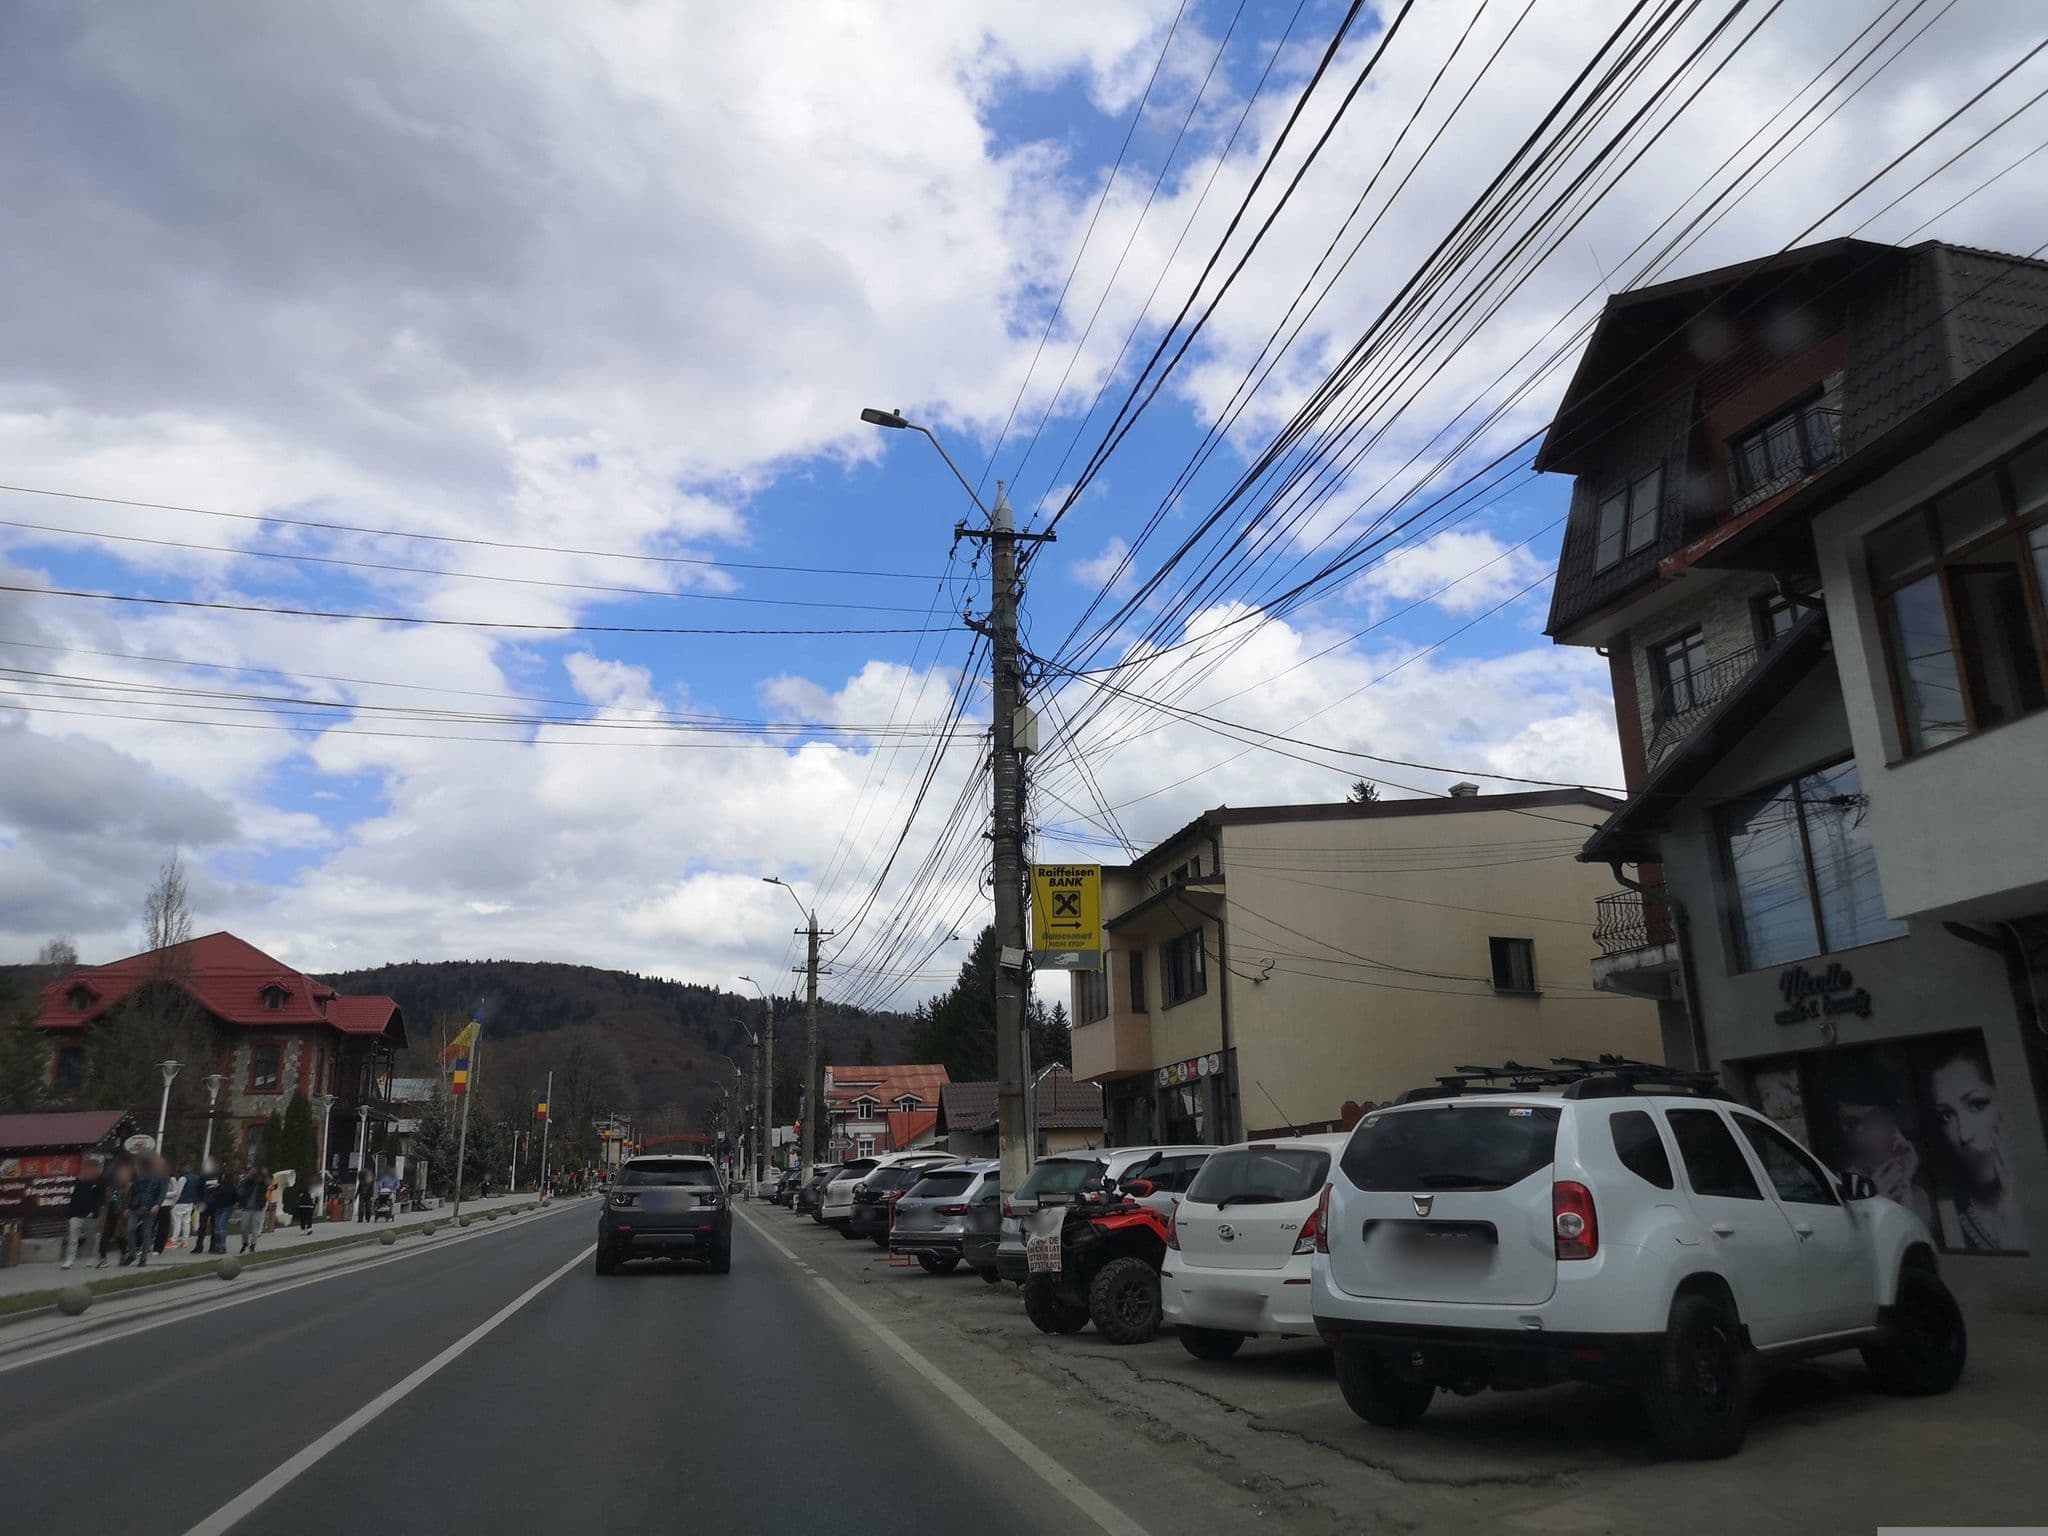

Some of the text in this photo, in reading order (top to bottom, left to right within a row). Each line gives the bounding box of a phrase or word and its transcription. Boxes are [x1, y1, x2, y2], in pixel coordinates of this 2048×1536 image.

[1038, 867, 1094, 878] Raiffeisen
[1049, 878, 1084, 887] BANK
[1049, 1237, 1059, 1245] DE
